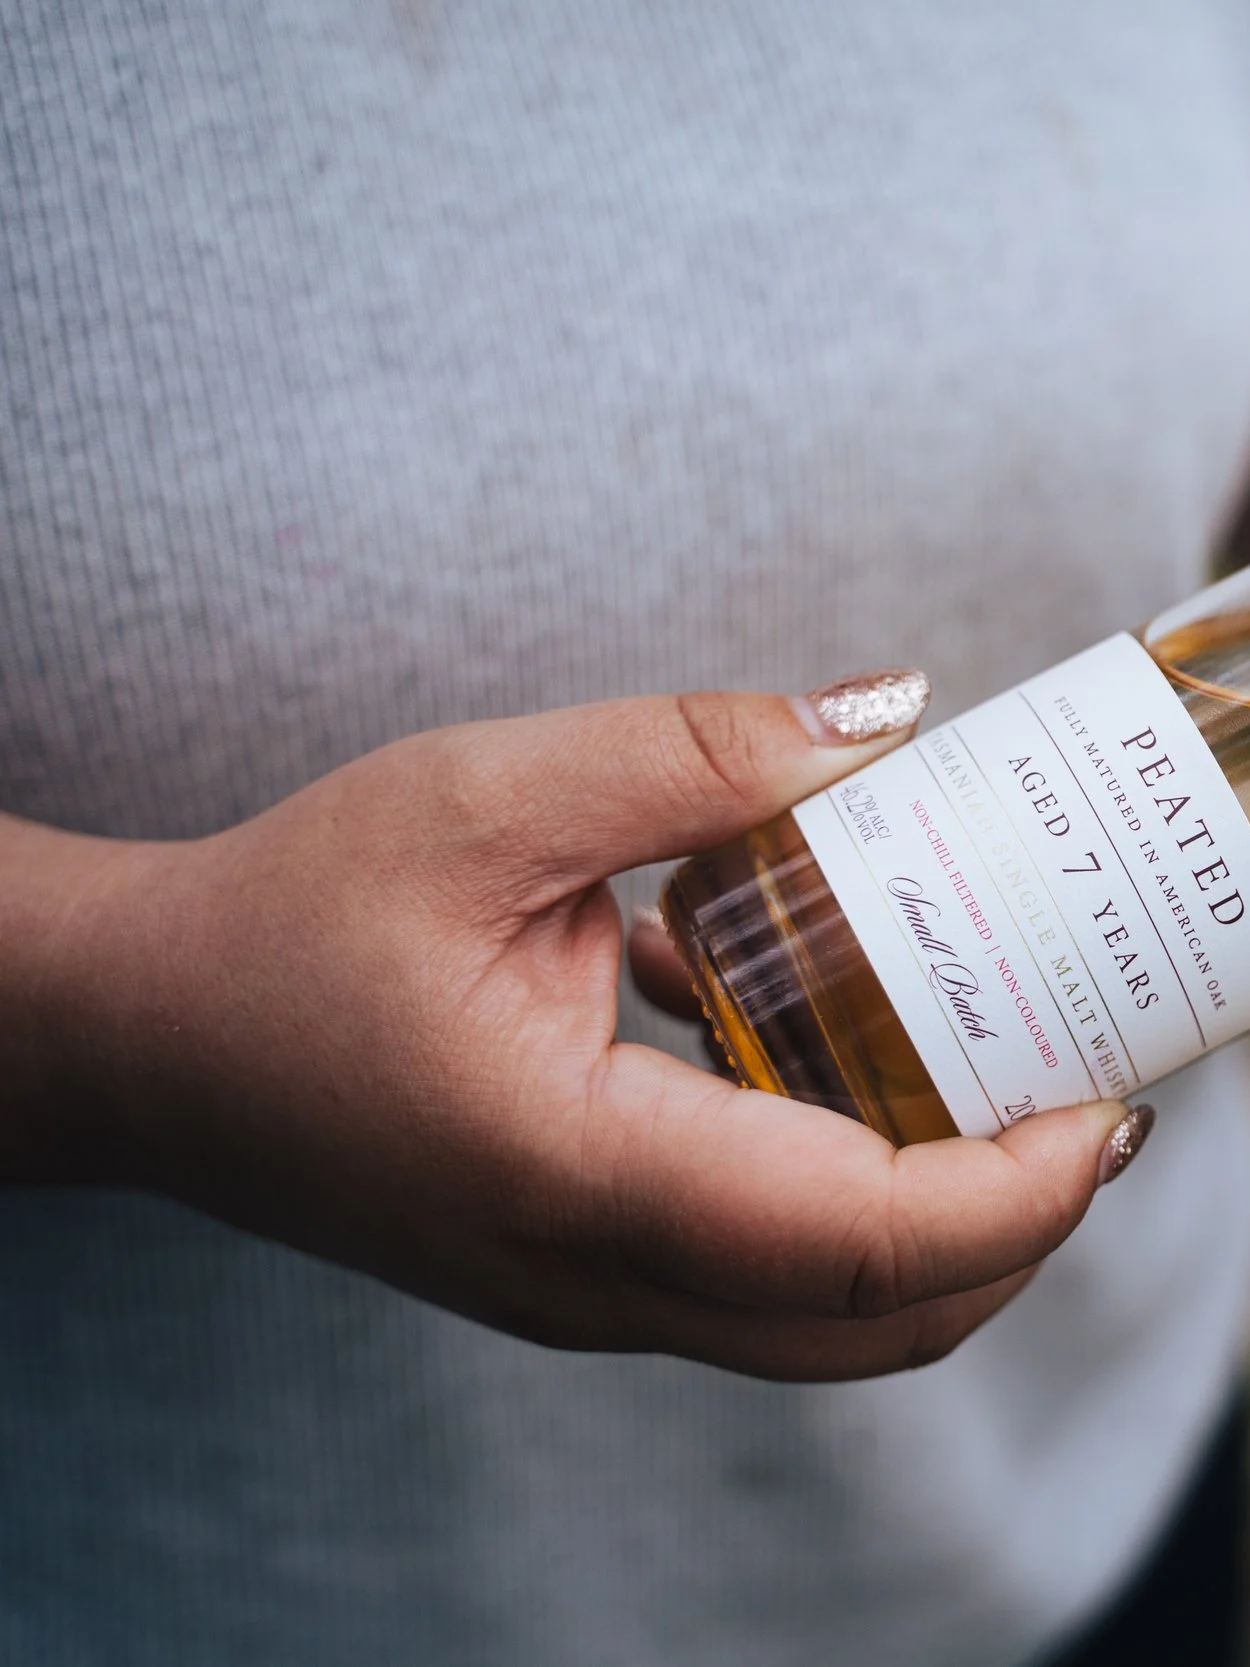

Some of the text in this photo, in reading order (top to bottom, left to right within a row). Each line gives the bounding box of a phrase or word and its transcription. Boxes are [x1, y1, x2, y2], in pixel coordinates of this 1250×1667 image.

[857, 819, 877, 845] VOL
[1008, 755, 1160, 1010] AGED 7 YEARS
[1053, 695, 1228, 1011] FULLY MATURED IN AMERICAN OAK
[1120, 725, 1245, 925] PEATED
[886, 876, 1000, 1042] Small Batch
[909, 799, 955, 872] NON-CHILL
[948, 871, 993, 941] FILTERED
[993, 956, 1059, 1069] NON-COLOURED
[991, 841, 1056, 945] SINGLE
[1050, 954, 1098, 1025] MALT
[1005, 1095, 1037, 1121] 20
